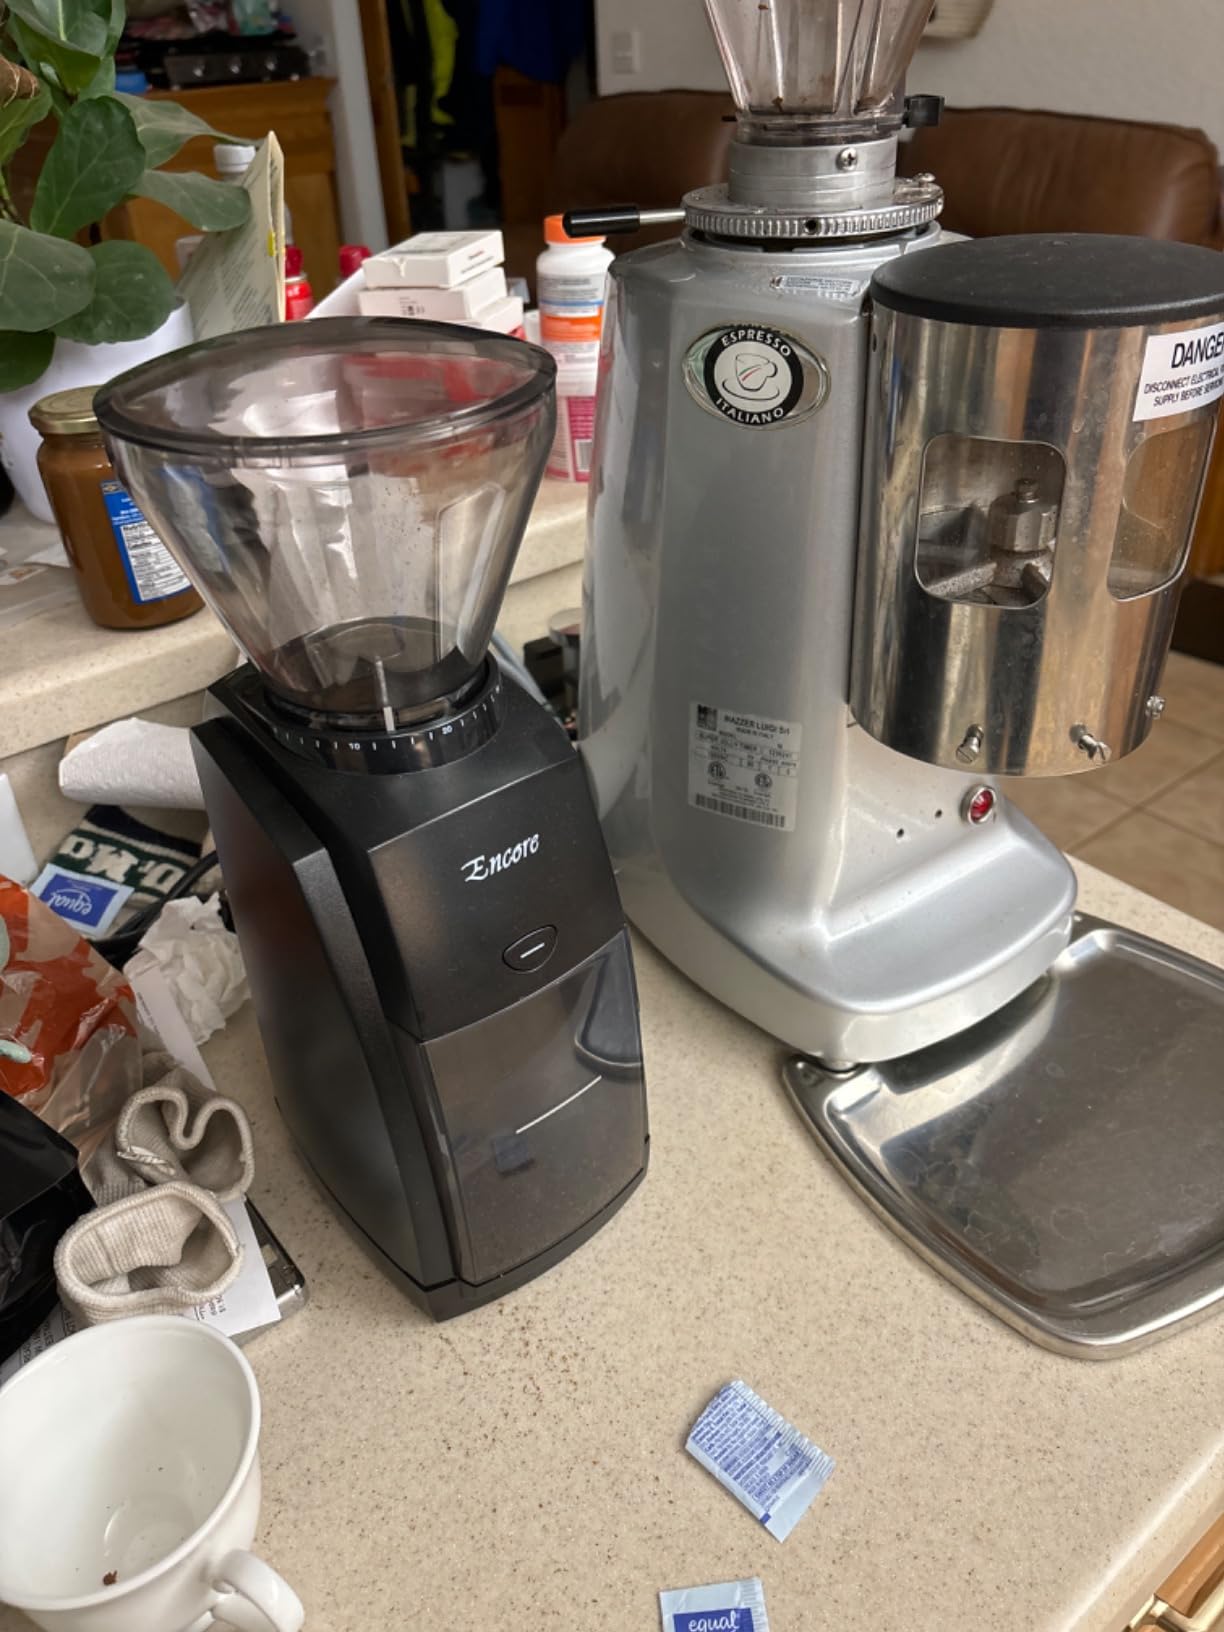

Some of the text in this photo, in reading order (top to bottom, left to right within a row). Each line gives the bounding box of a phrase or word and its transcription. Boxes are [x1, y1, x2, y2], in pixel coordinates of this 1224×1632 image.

[721, 329, 791, 356] ESPRESSO
[1144, 375, 1191, 395] DISCONNECT
[716, 397, 784, 424] ITALIANO
[1153, 392, 1180, 407] SUPPLY
[348, 742, 361, 751] 10
[460, 833, 540, 882] Encore
[49, 891, 93, 916] equal
[687, 1609, 740, 1632] equal
